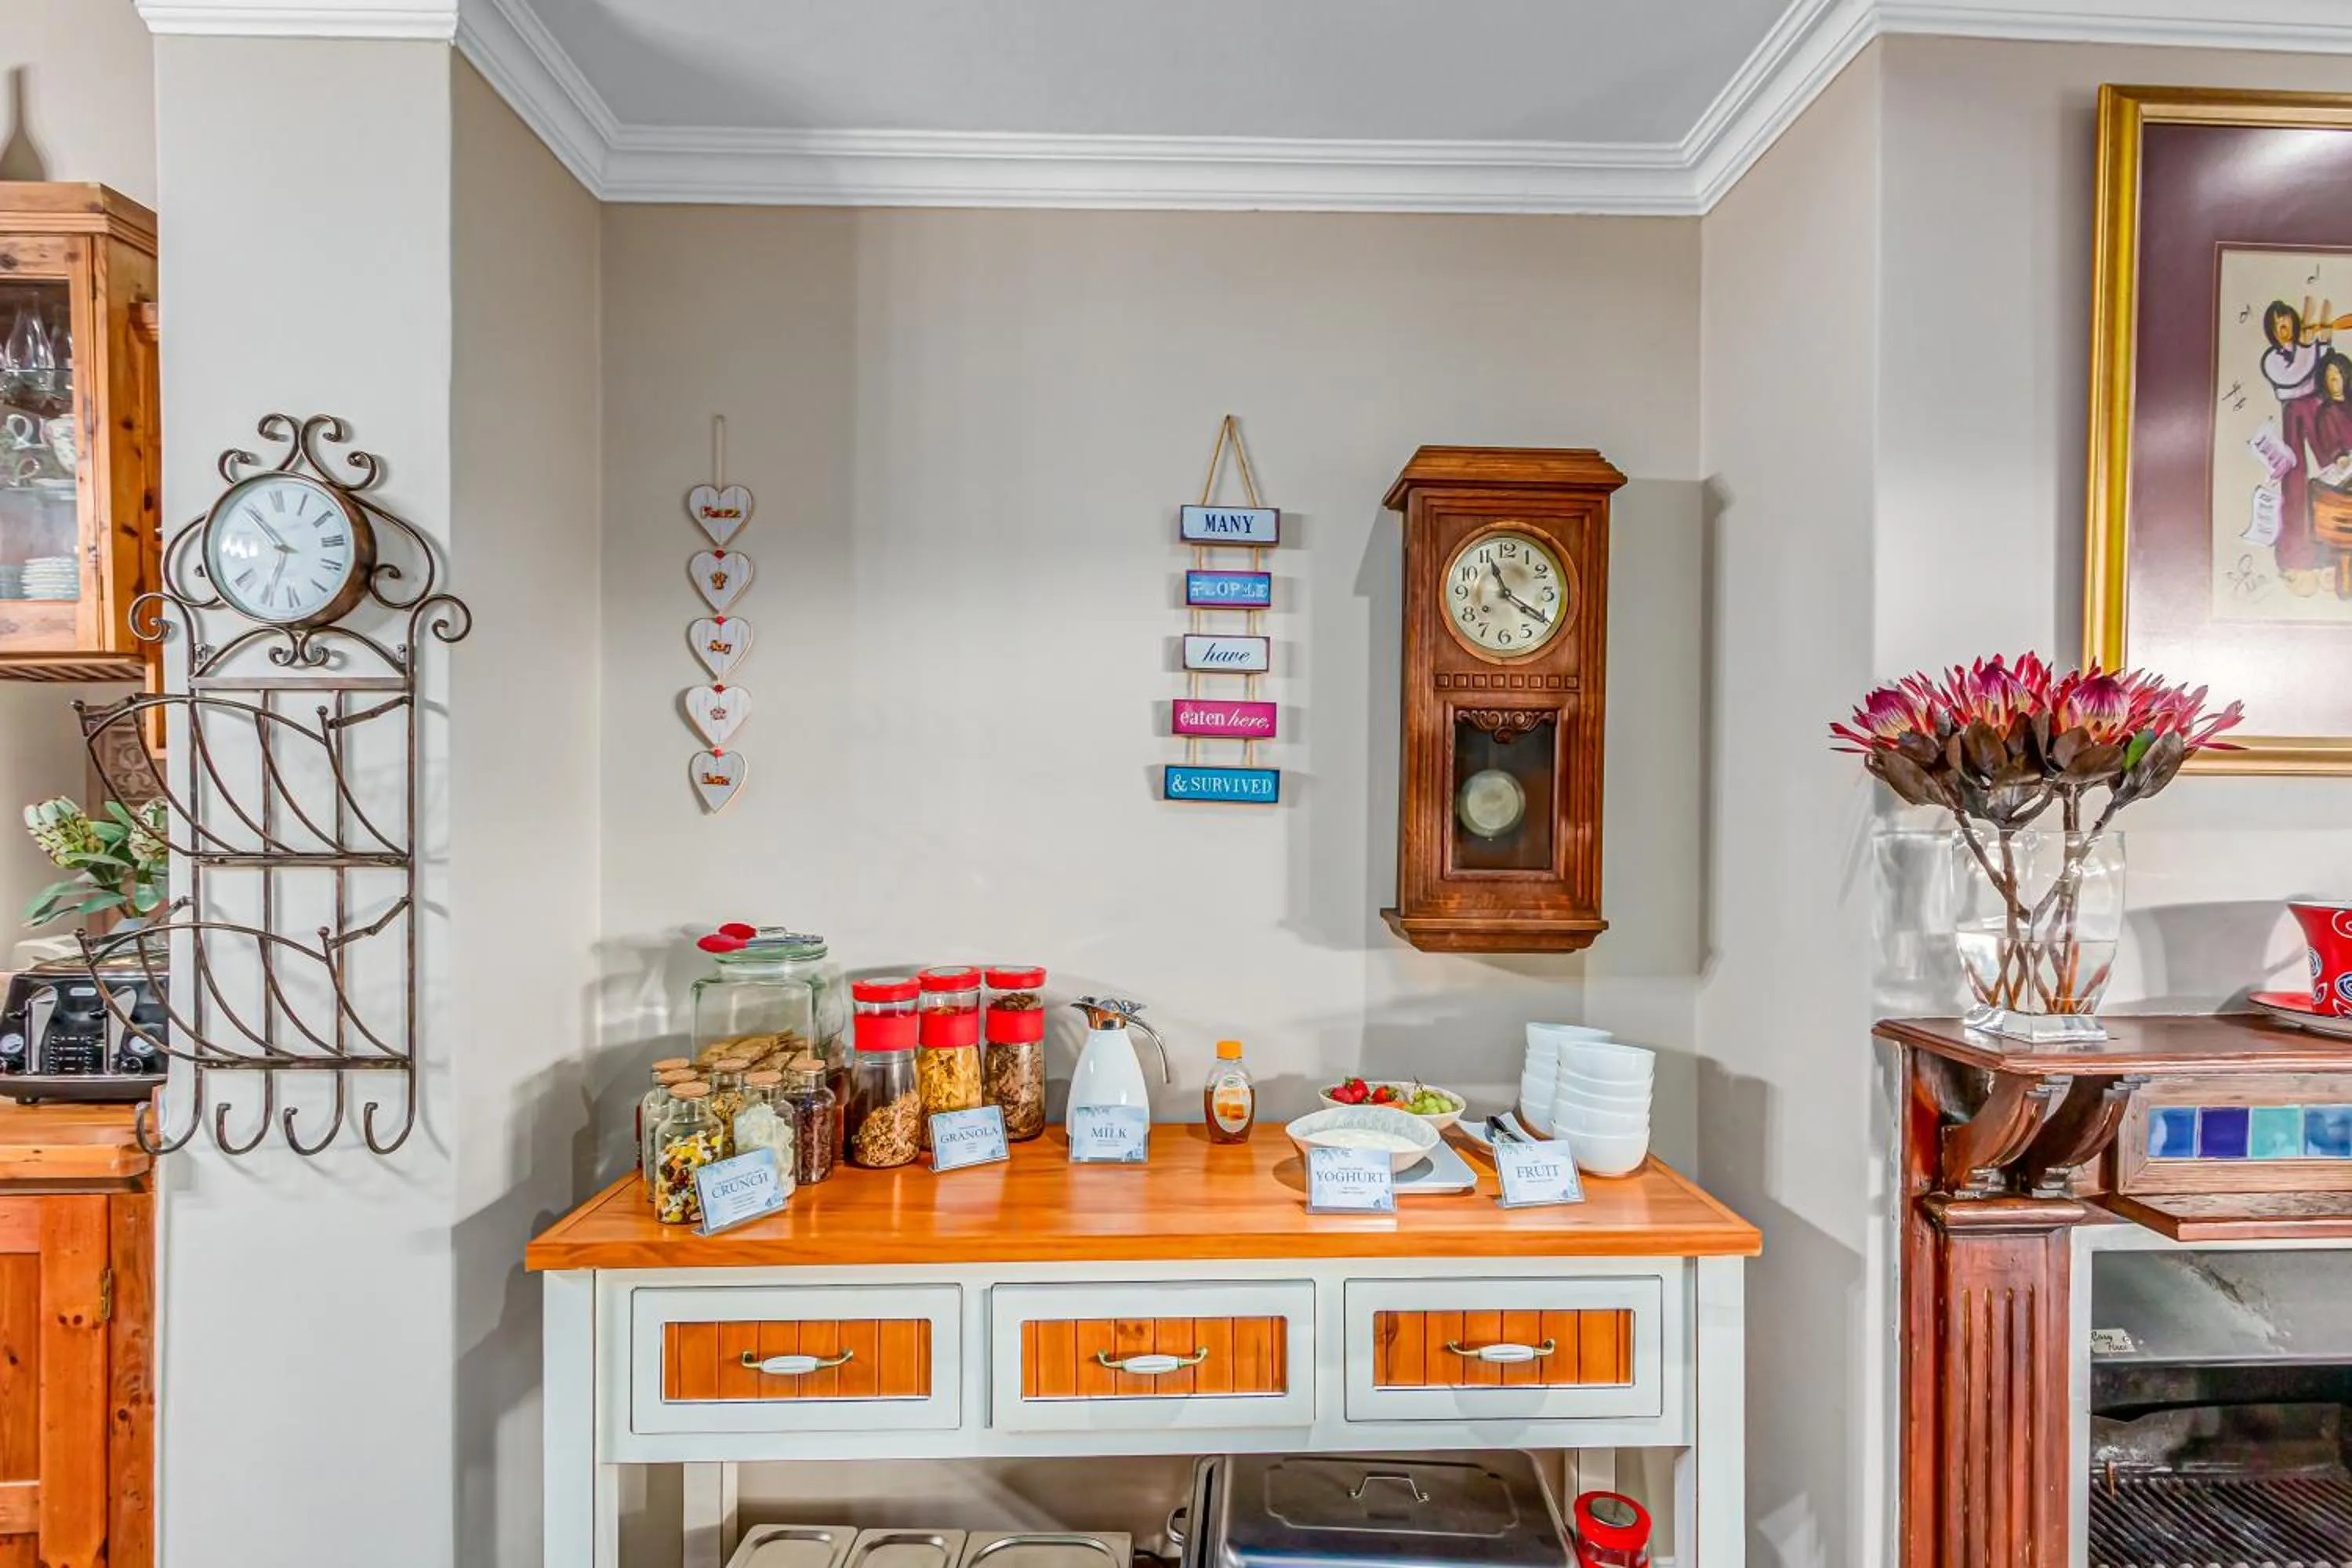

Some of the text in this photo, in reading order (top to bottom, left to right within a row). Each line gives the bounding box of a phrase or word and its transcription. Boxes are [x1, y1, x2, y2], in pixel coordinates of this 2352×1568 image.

[1203, 514, 1255, 534] MANY
[1479, 550, 1490, 564] 11
[1498, 543, 1516, 559] 12
[1525, 550, 1530, 565] 1
[1461, 565, 1478, 582] 10
[1533, 564, 1548, 579] 2
[1454, 584, 1468, 601] 9
[1541, 586, 1555, 602] 3
[1461, 605, 1475, 622] 8
[1477, 622, 1490, 638] 7
[1497, 628, 1512, 644] 6
[1519, 623, 1533, 639] 5
[1203, 642, 1250, 663] have
[1179, 710, 1225, 726] eaten
[1172, 774, 1272, 795] & SURVIVED
[940, 1126, 999, 1144] GRANOLA
[1091, 1126, 1129, 1139] MILK
[1316, 1171, 1385, 1184] YOGHURT
[1515, 1164, 1559, 1178] FRUIT
[711, 1171, 769, 1200] CRUNCH
